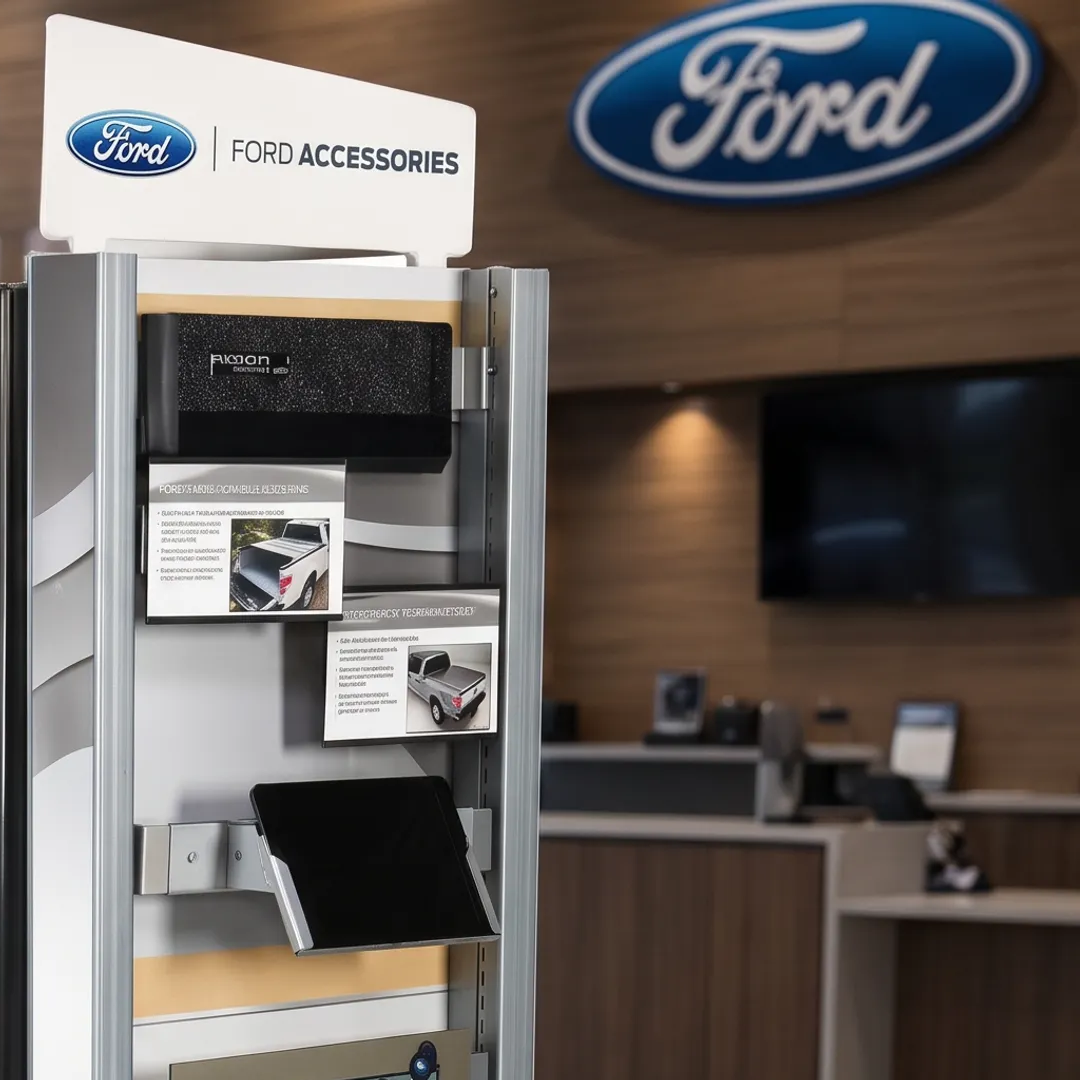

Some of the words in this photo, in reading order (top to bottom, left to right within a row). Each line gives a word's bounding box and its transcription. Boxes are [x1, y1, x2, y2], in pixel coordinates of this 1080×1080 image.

[652, 18, 939, 171] Ford
[93, 120, 172, 165] Ford
[232, 139, 294, 165] FORD
[298, 143, 459, 175] ACCESSORIES
